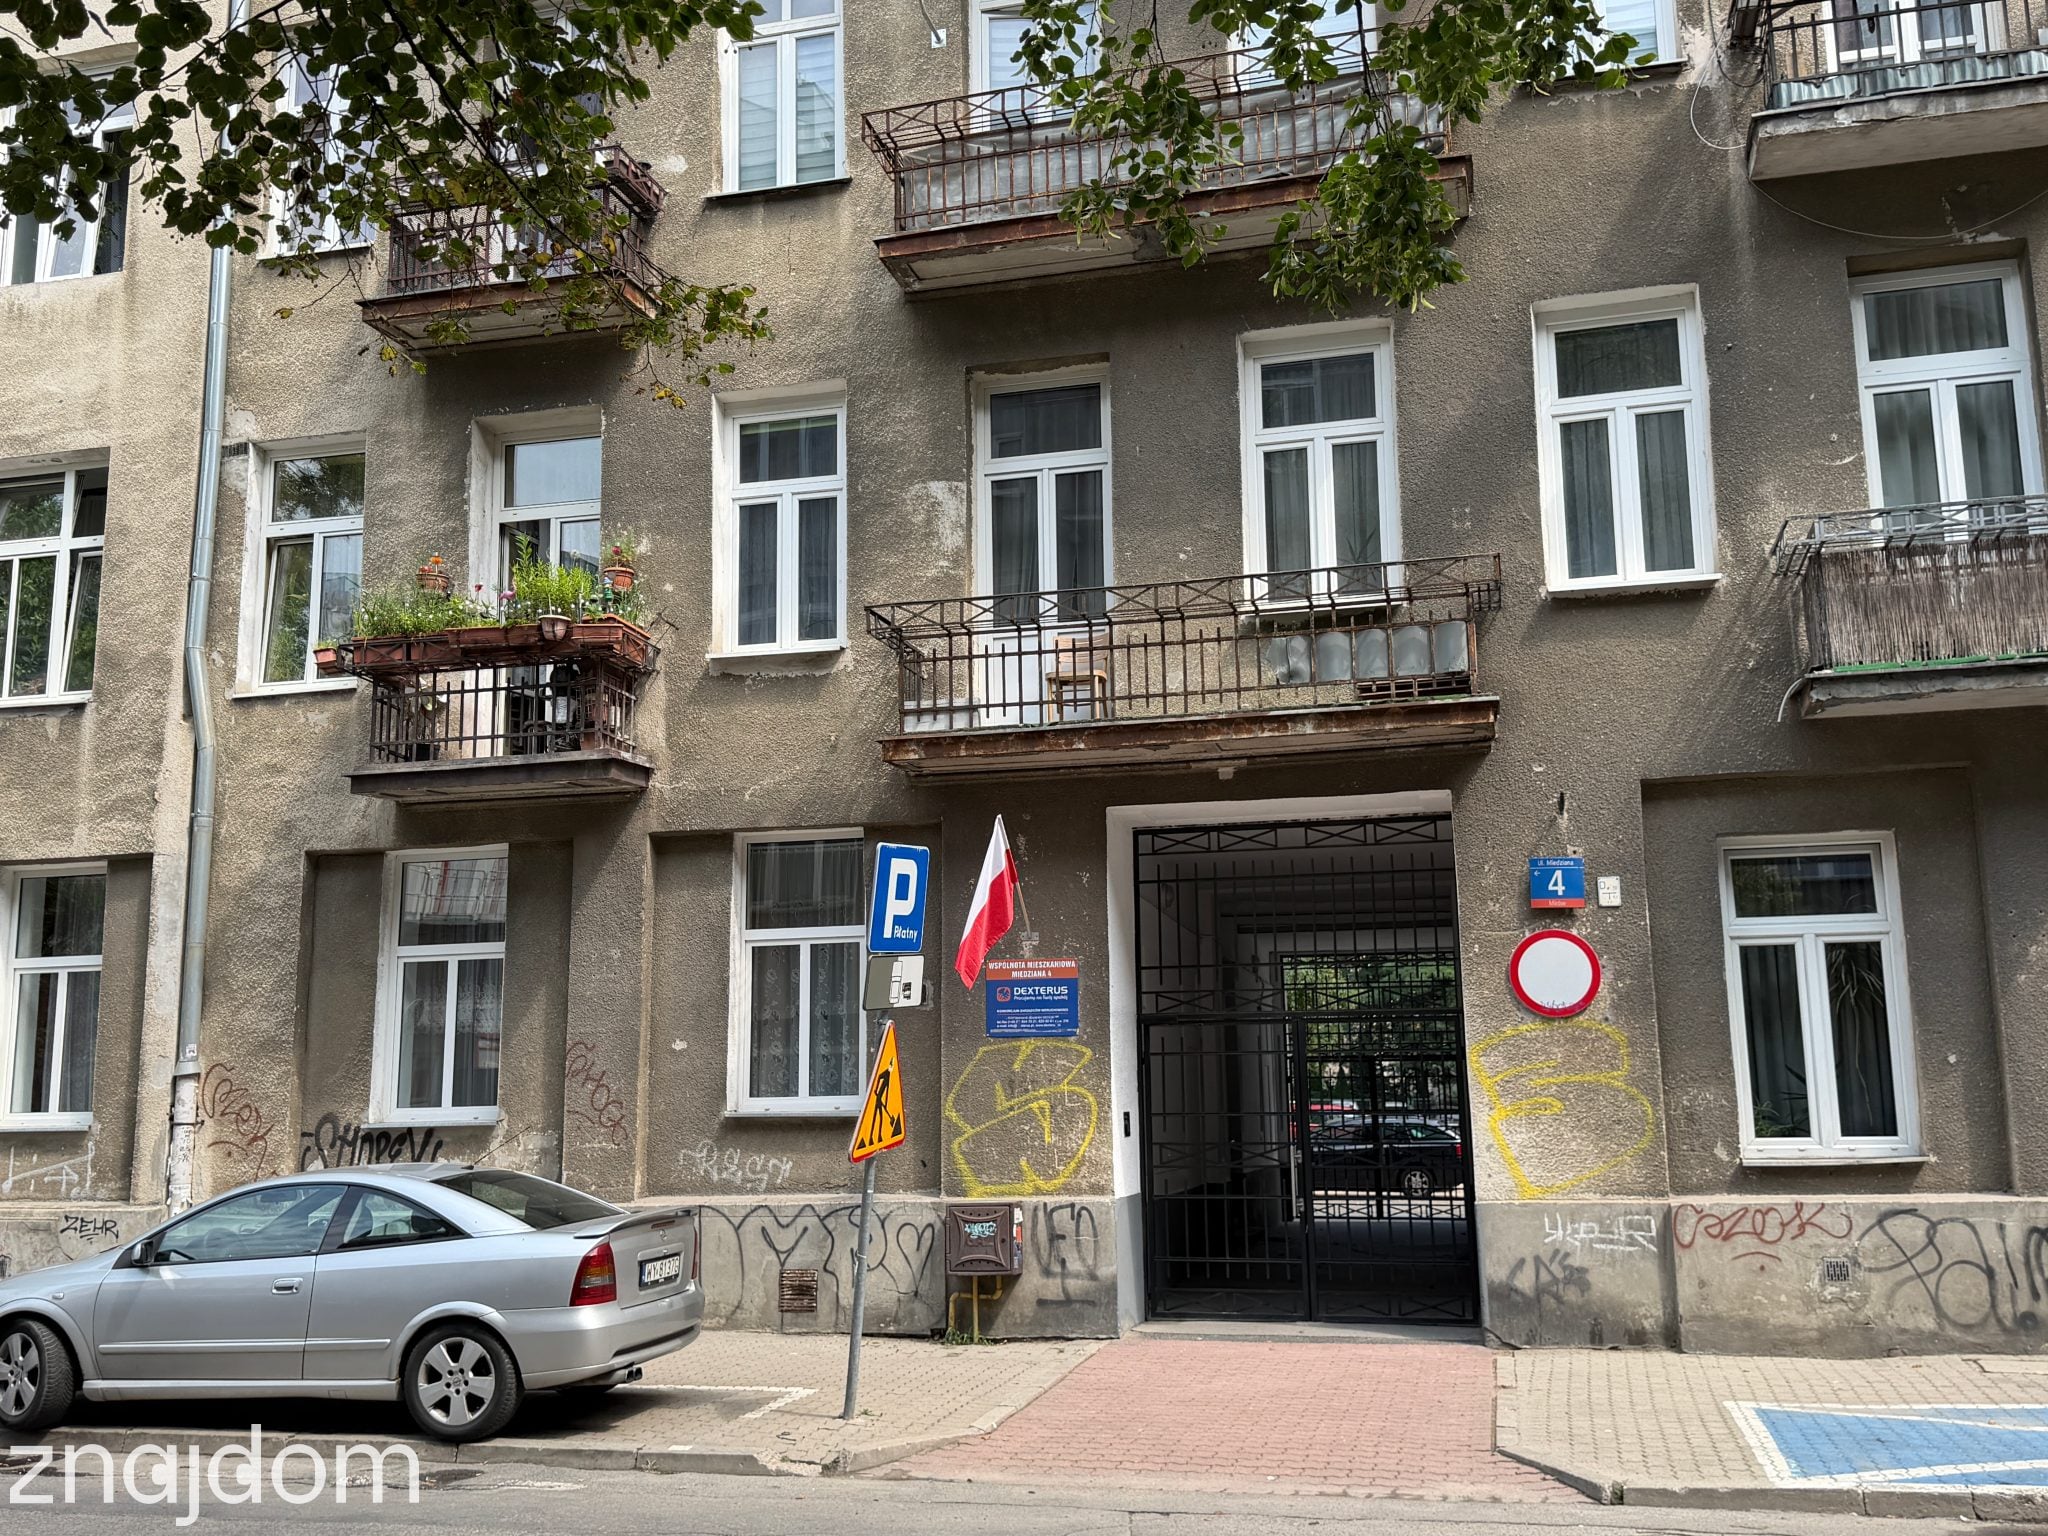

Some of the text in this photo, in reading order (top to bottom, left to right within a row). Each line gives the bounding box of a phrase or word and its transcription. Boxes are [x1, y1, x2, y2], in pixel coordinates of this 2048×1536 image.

[1548, 869, 1566, 896] 4
[883, 858, 918, 938] P
[1027, 960, 1076, 968] MIESZKANIOWA
[1011, 970, 1046, 978] MIEDZIANA
[1013, 986, 1068, 995] DEXTERUS
